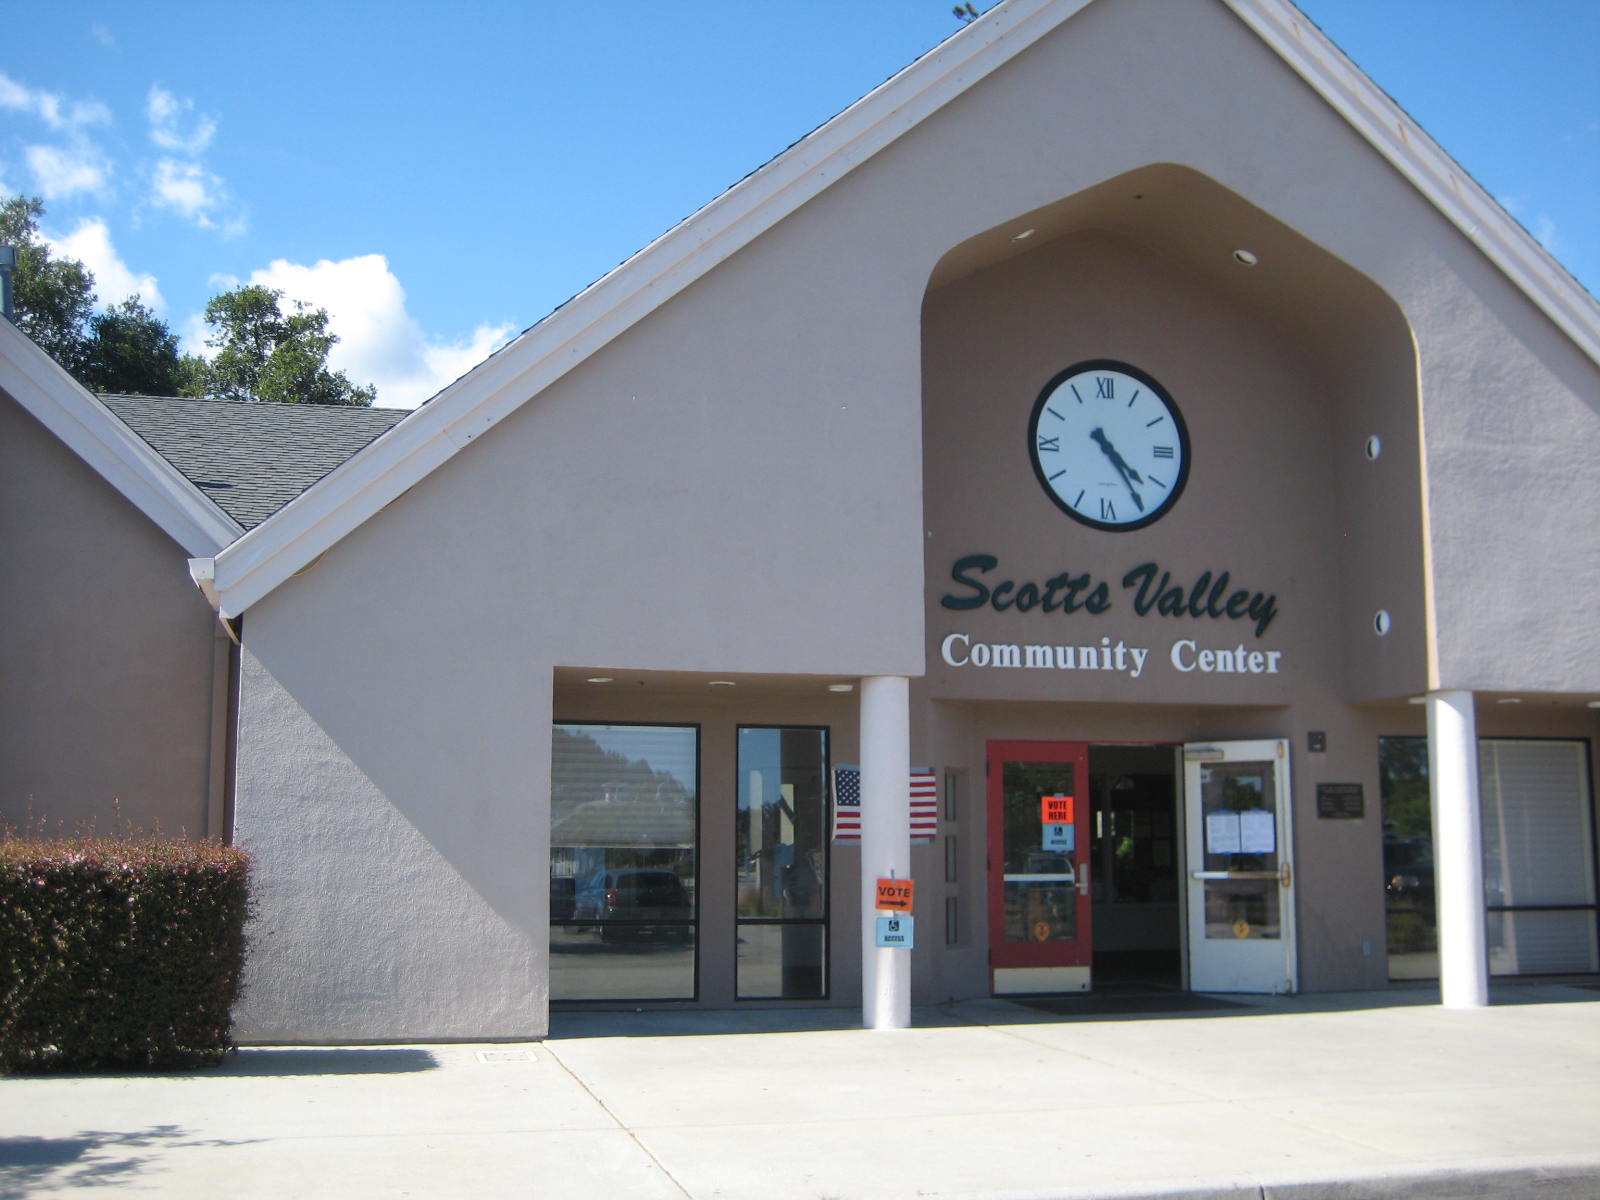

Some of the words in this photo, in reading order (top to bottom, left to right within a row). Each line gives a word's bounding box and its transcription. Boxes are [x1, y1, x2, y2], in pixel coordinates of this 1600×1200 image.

[941, 554, 1112, 615] Scotts
[1122, 562, 1278, 638] Valley
[941, 633, 1149, 677] Community
[1170, 640, 1281, 673] Center
[1048, 801, 1067, 810] VOTE
[1048, 811, 1067, 821] HERE
[878, 887, 911, 898] VOTE
